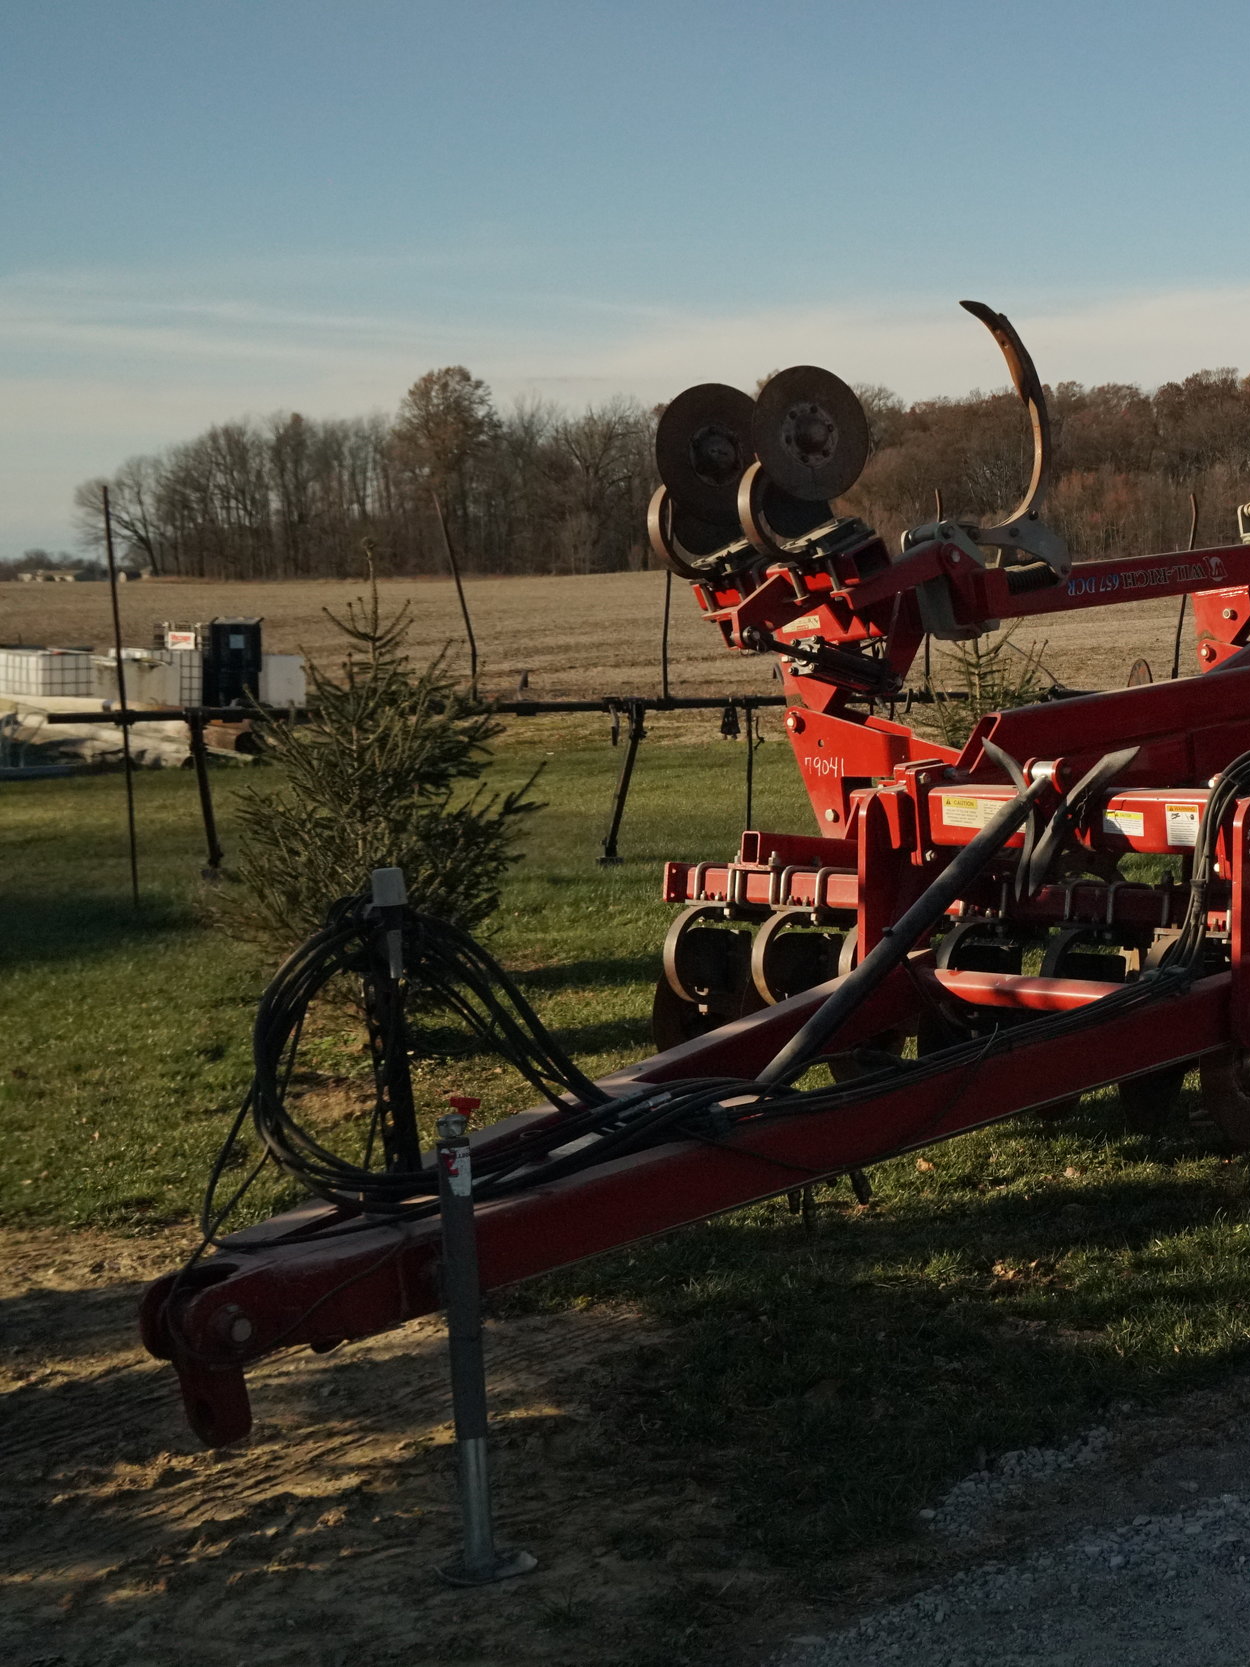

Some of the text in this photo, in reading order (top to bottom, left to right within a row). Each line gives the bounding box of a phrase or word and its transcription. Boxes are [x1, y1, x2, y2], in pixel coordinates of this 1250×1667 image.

[1099, 573, 1120, 592] 657
[1120, 563, 1207, 589] WIL-RICH
[1067, 577, 1096, 596] DCR
[804, 756, 844, 778] 79041
[953, 799, 975, 807] CAUTION
